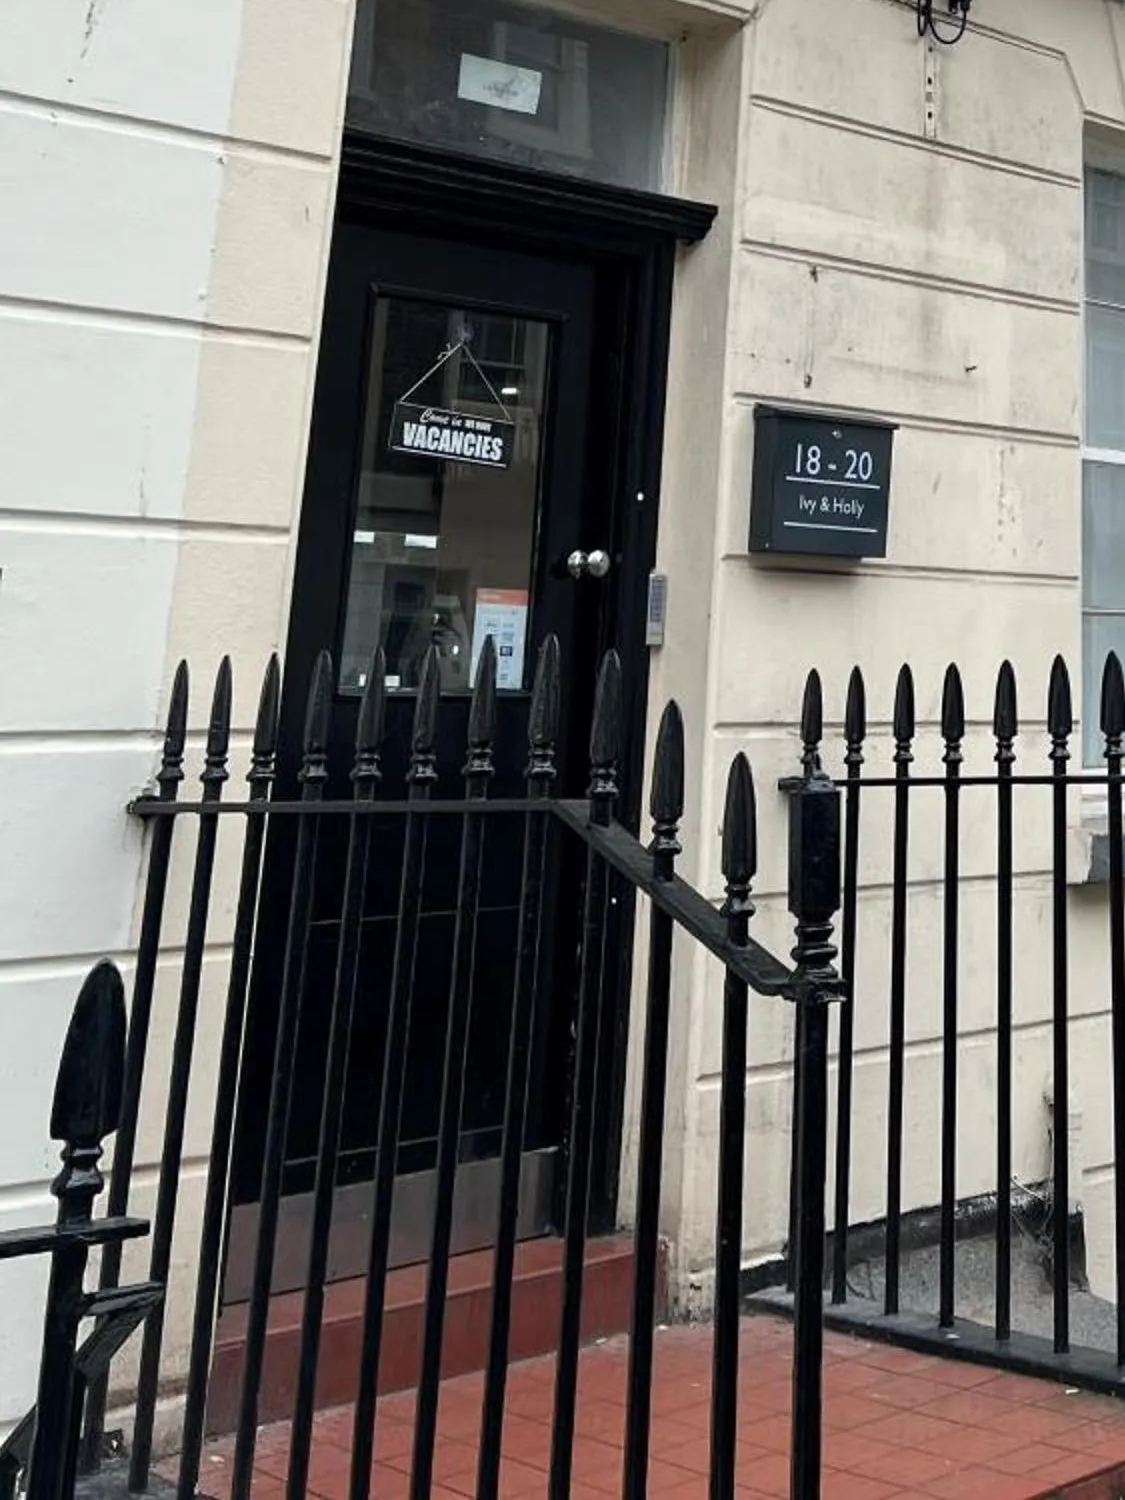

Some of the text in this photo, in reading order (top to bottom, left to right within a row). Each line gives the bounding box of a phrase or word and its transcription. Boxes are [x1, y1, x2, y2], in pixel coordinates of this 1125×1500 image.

[403, 421, 503, 461] VACANCIES
[795, 444, 821, 475] 18
[844, 449, 873, 481] 20
[799, 494, 865, 519] Ivy & Holly
